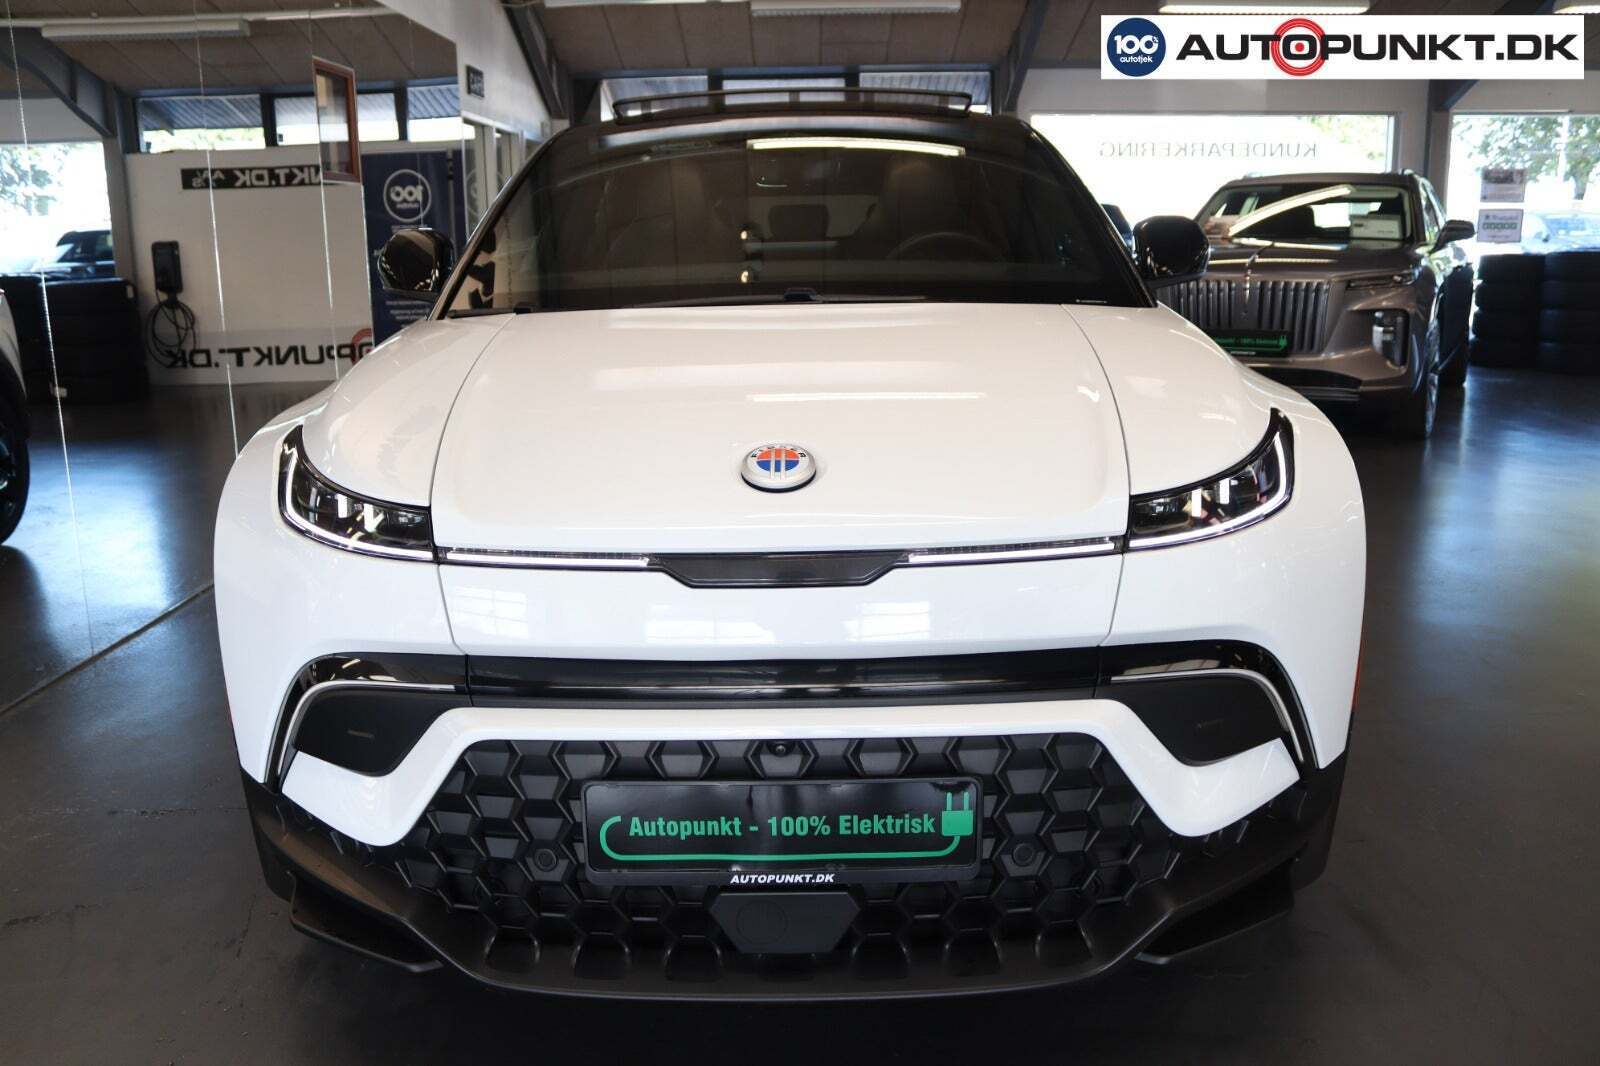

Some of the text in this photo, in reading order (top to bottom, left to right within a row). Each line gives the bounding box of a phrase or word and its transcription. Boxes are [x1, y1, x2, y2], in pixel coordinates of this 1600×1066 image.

[628, 814, 742, 841] Autopunkt
[767, 815, 831, 837] 100%
[839, 813, 936, 836] Elektrisk
[729, 872, 836, 884] AUTOPUNKT.DK
